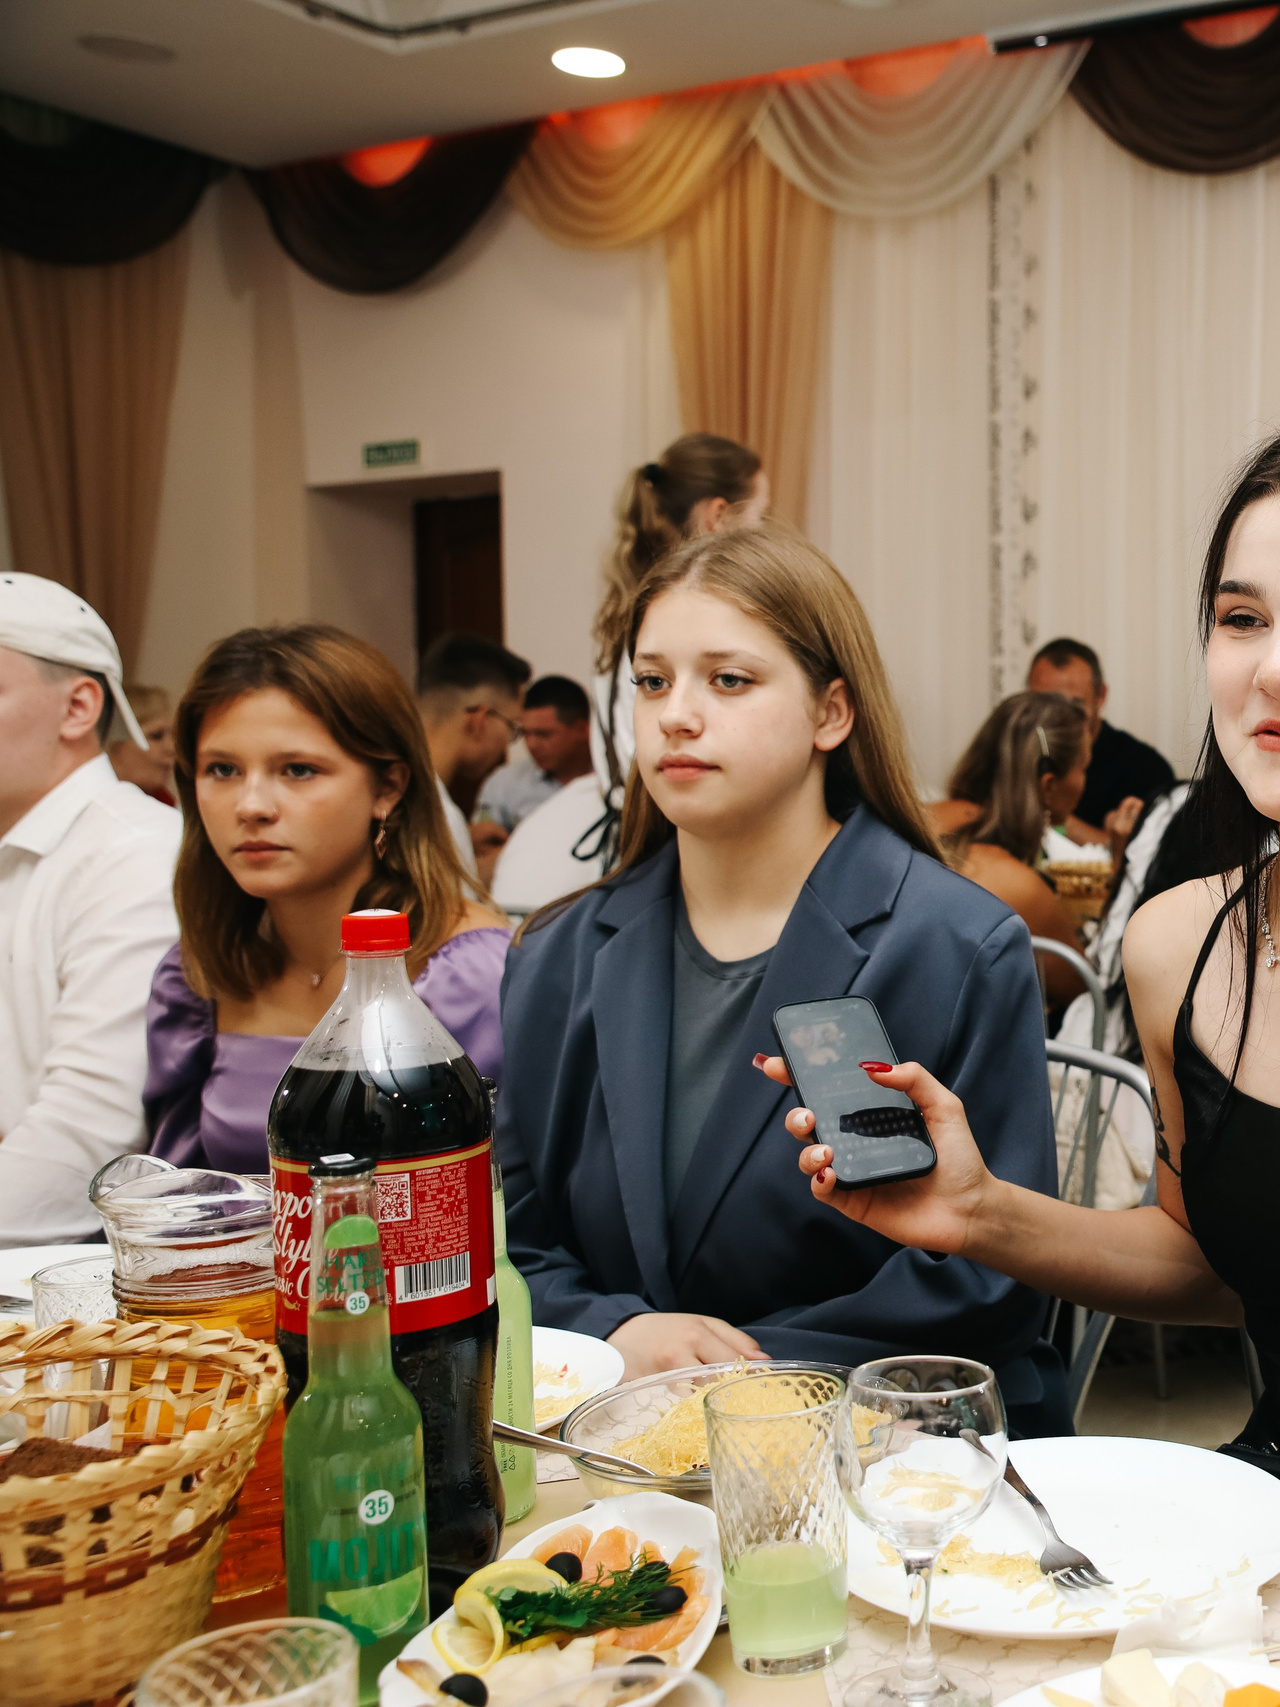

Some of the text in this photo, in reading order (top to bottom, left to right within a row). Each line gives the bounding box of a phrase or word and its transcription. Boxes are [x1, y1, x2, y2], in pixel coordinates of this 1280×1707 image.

[325, 1248, 380, 1271] HARD
[350, 1295, 366, 1311] 35
[410, 1290, 437, 1300] 601351
[443, 1283, 466, 1293] 019404
[364, 1494, 389, 1519] 35
[310, 1521, 416, 1583] MOJIT
